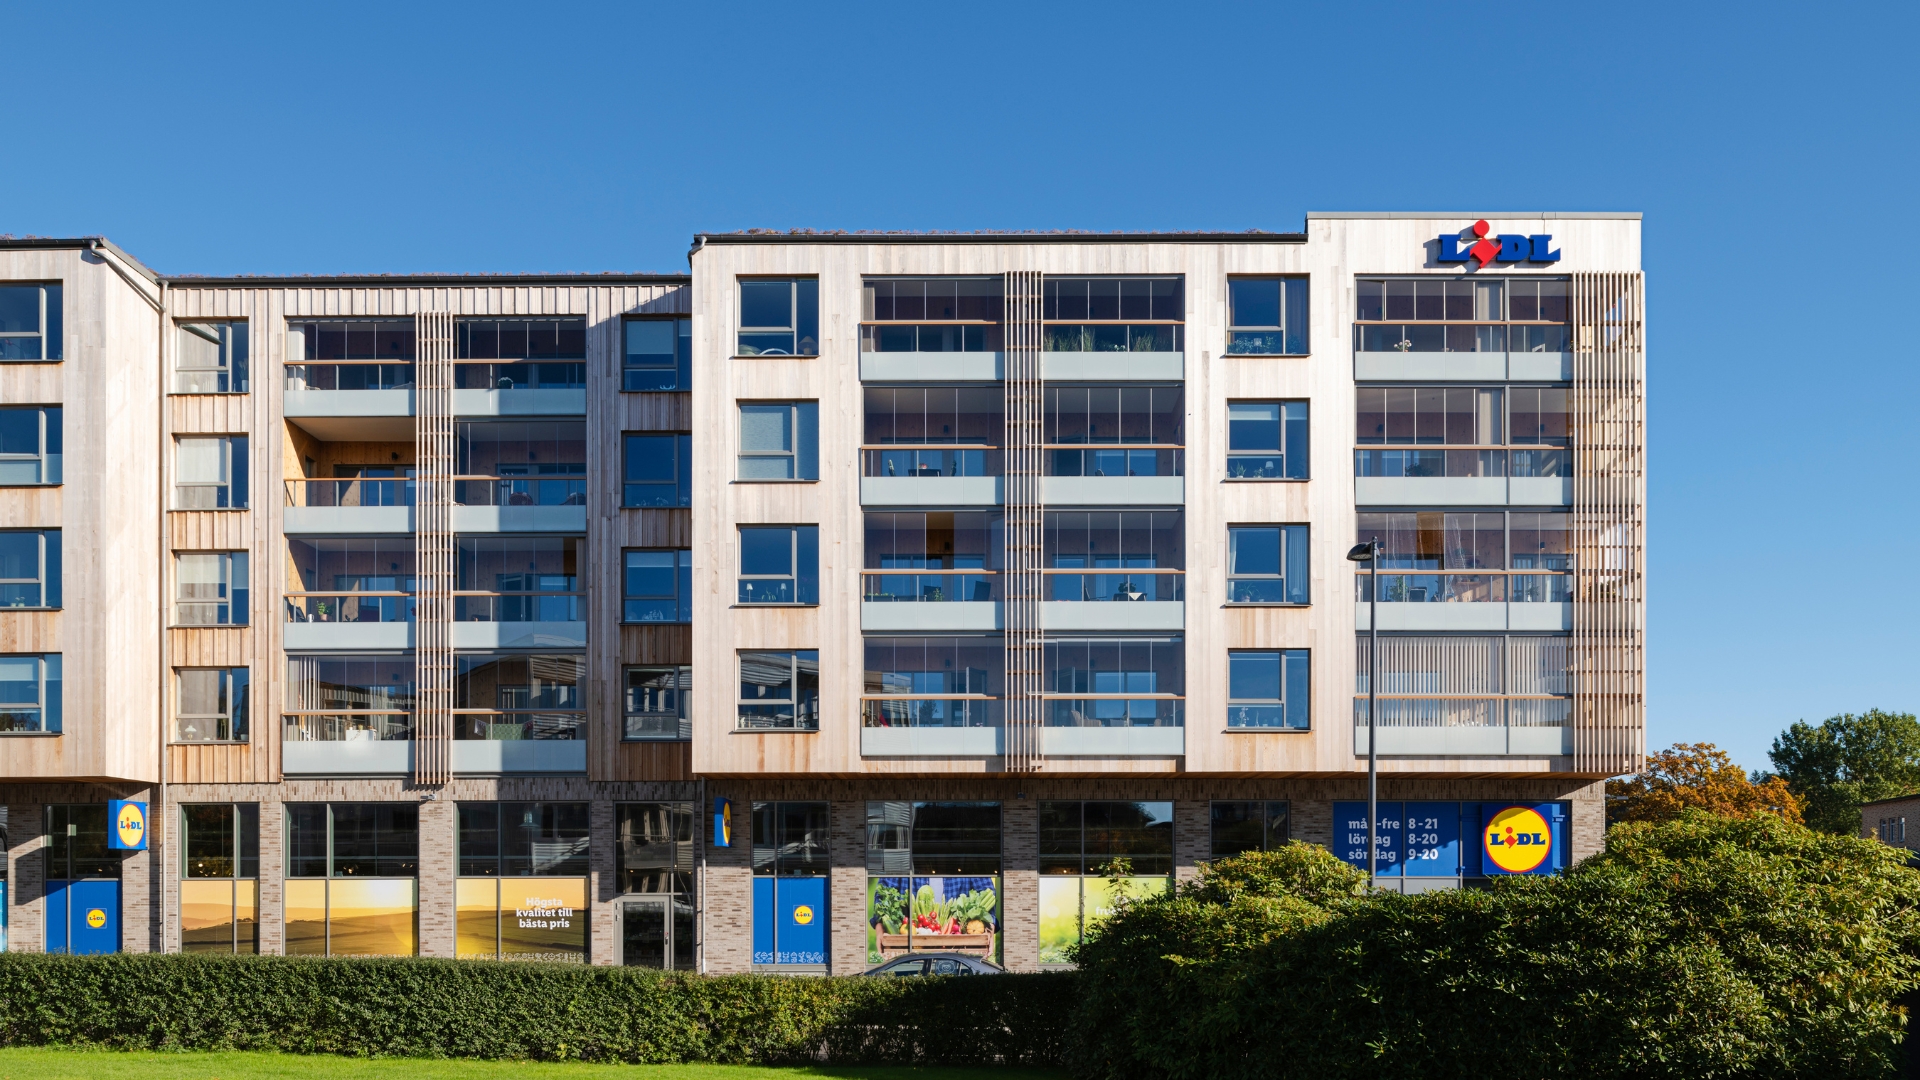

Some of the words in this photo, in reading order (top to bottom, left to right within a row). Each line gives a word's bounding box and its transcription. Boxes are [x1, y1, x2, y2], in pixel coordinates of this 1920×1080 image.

[1348, 817, 1400, 829] må-fre
[1348, 833, 1391, 847] lörag
[1408, 848, 1439, 860] 9-20
[526, 897, 563, 908] Högsta
[516, 908, 556, 917] kvalitet
[558, 908, 573, 917] till
[519, 918, 548, 928] bästa
[549, 918, 570, 930] pris
